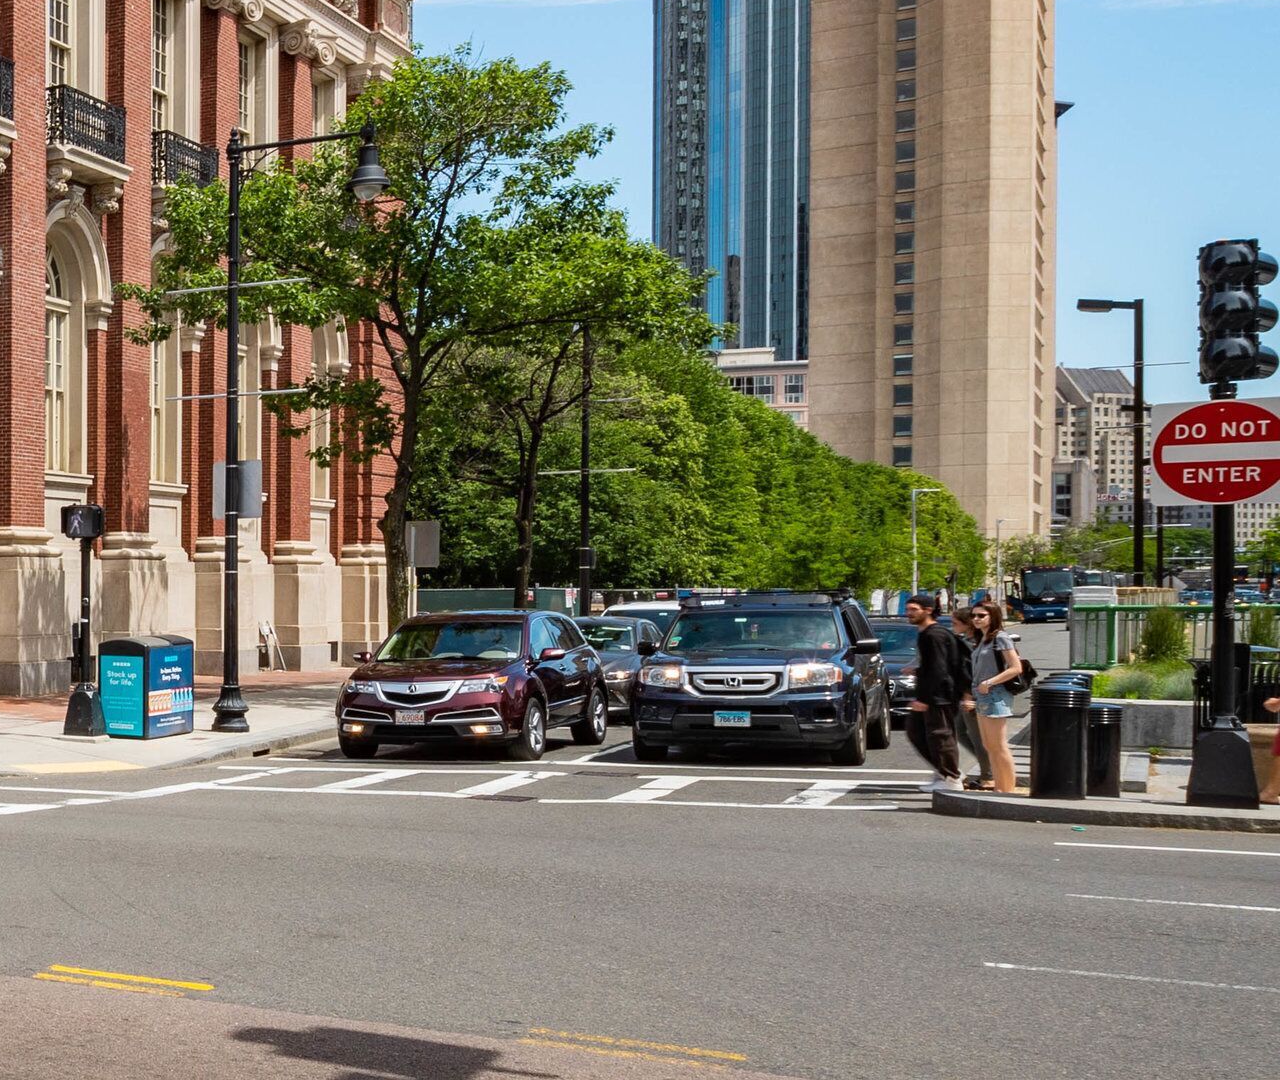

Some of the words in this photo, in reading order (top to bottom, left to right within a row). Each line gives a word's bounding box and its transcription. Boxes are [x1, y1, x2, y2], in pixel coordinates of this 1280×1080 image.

[1175, 423, 1207, 439] DO
[1221, 420, 1271, 437] NOT
[1182, 466, 1261, 484] ENTER
[106, 670, 126, 678] Stock
[127, 672, 137, 680] up
[109, 677, 119, 685] for
